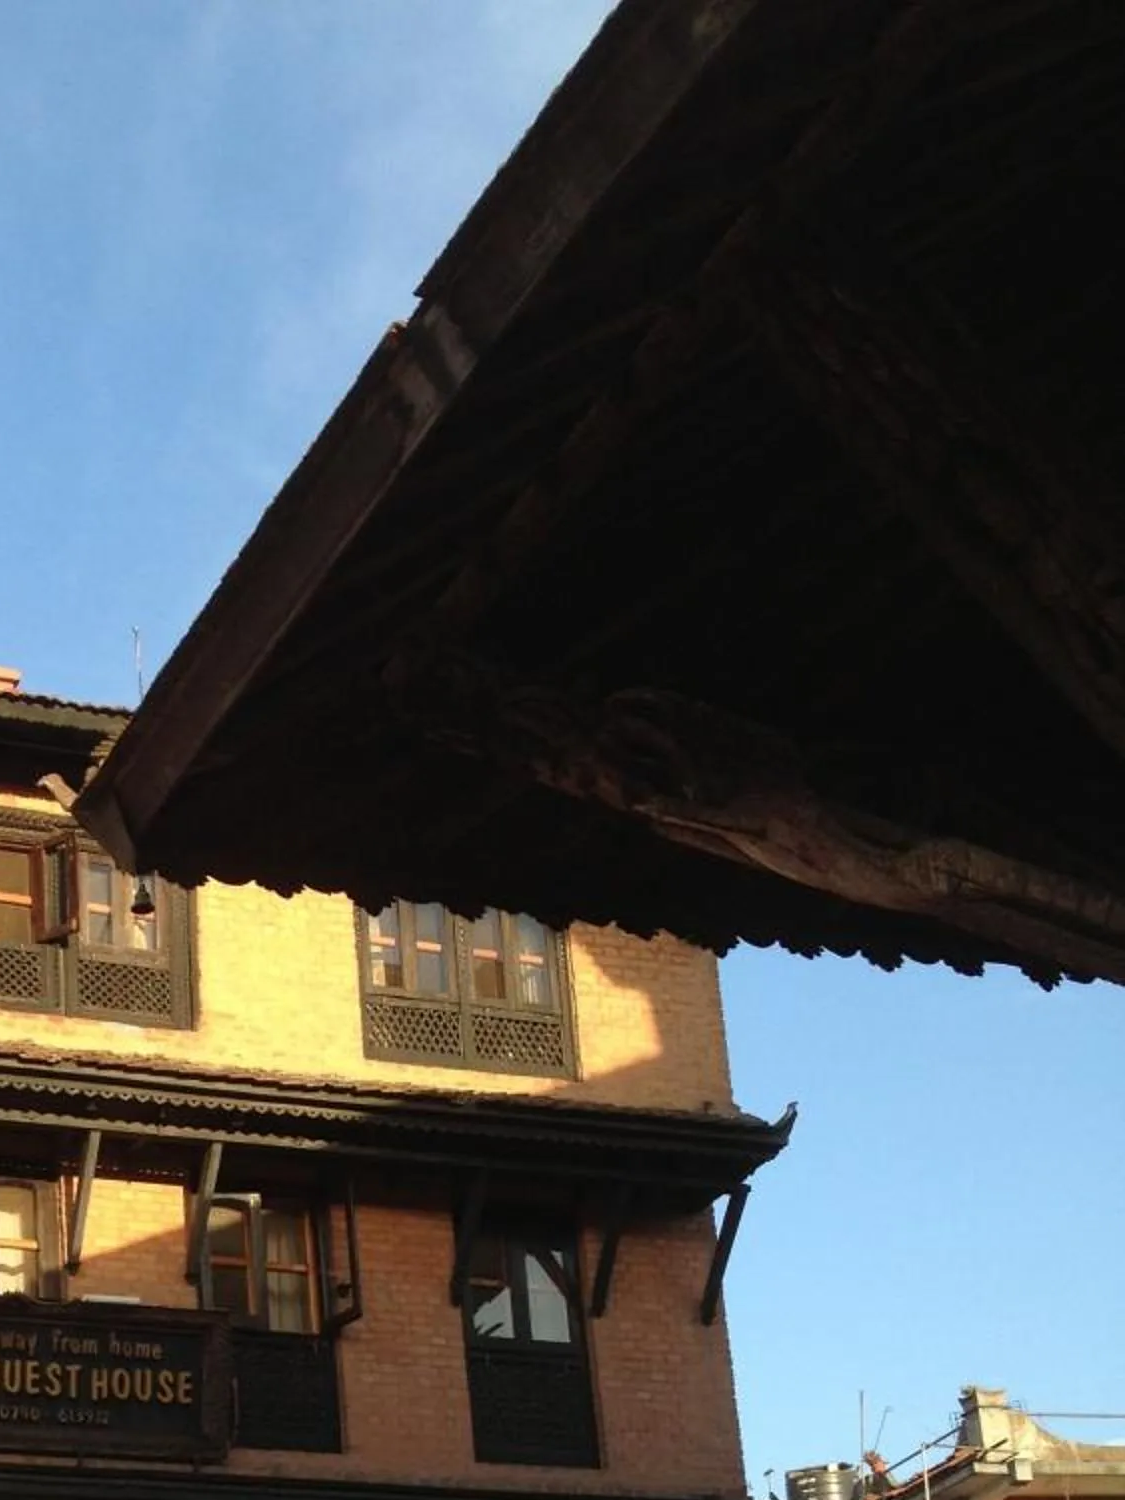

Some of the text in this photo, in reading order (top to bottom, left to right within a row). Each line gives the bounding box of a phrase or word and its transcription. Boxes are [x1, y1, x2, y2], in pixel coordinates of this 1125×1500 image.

[52, 1329, 99, 1356] from
[109, 1333, 164, 1360] home
[91, 1368, 193, 1403] HOUSE
